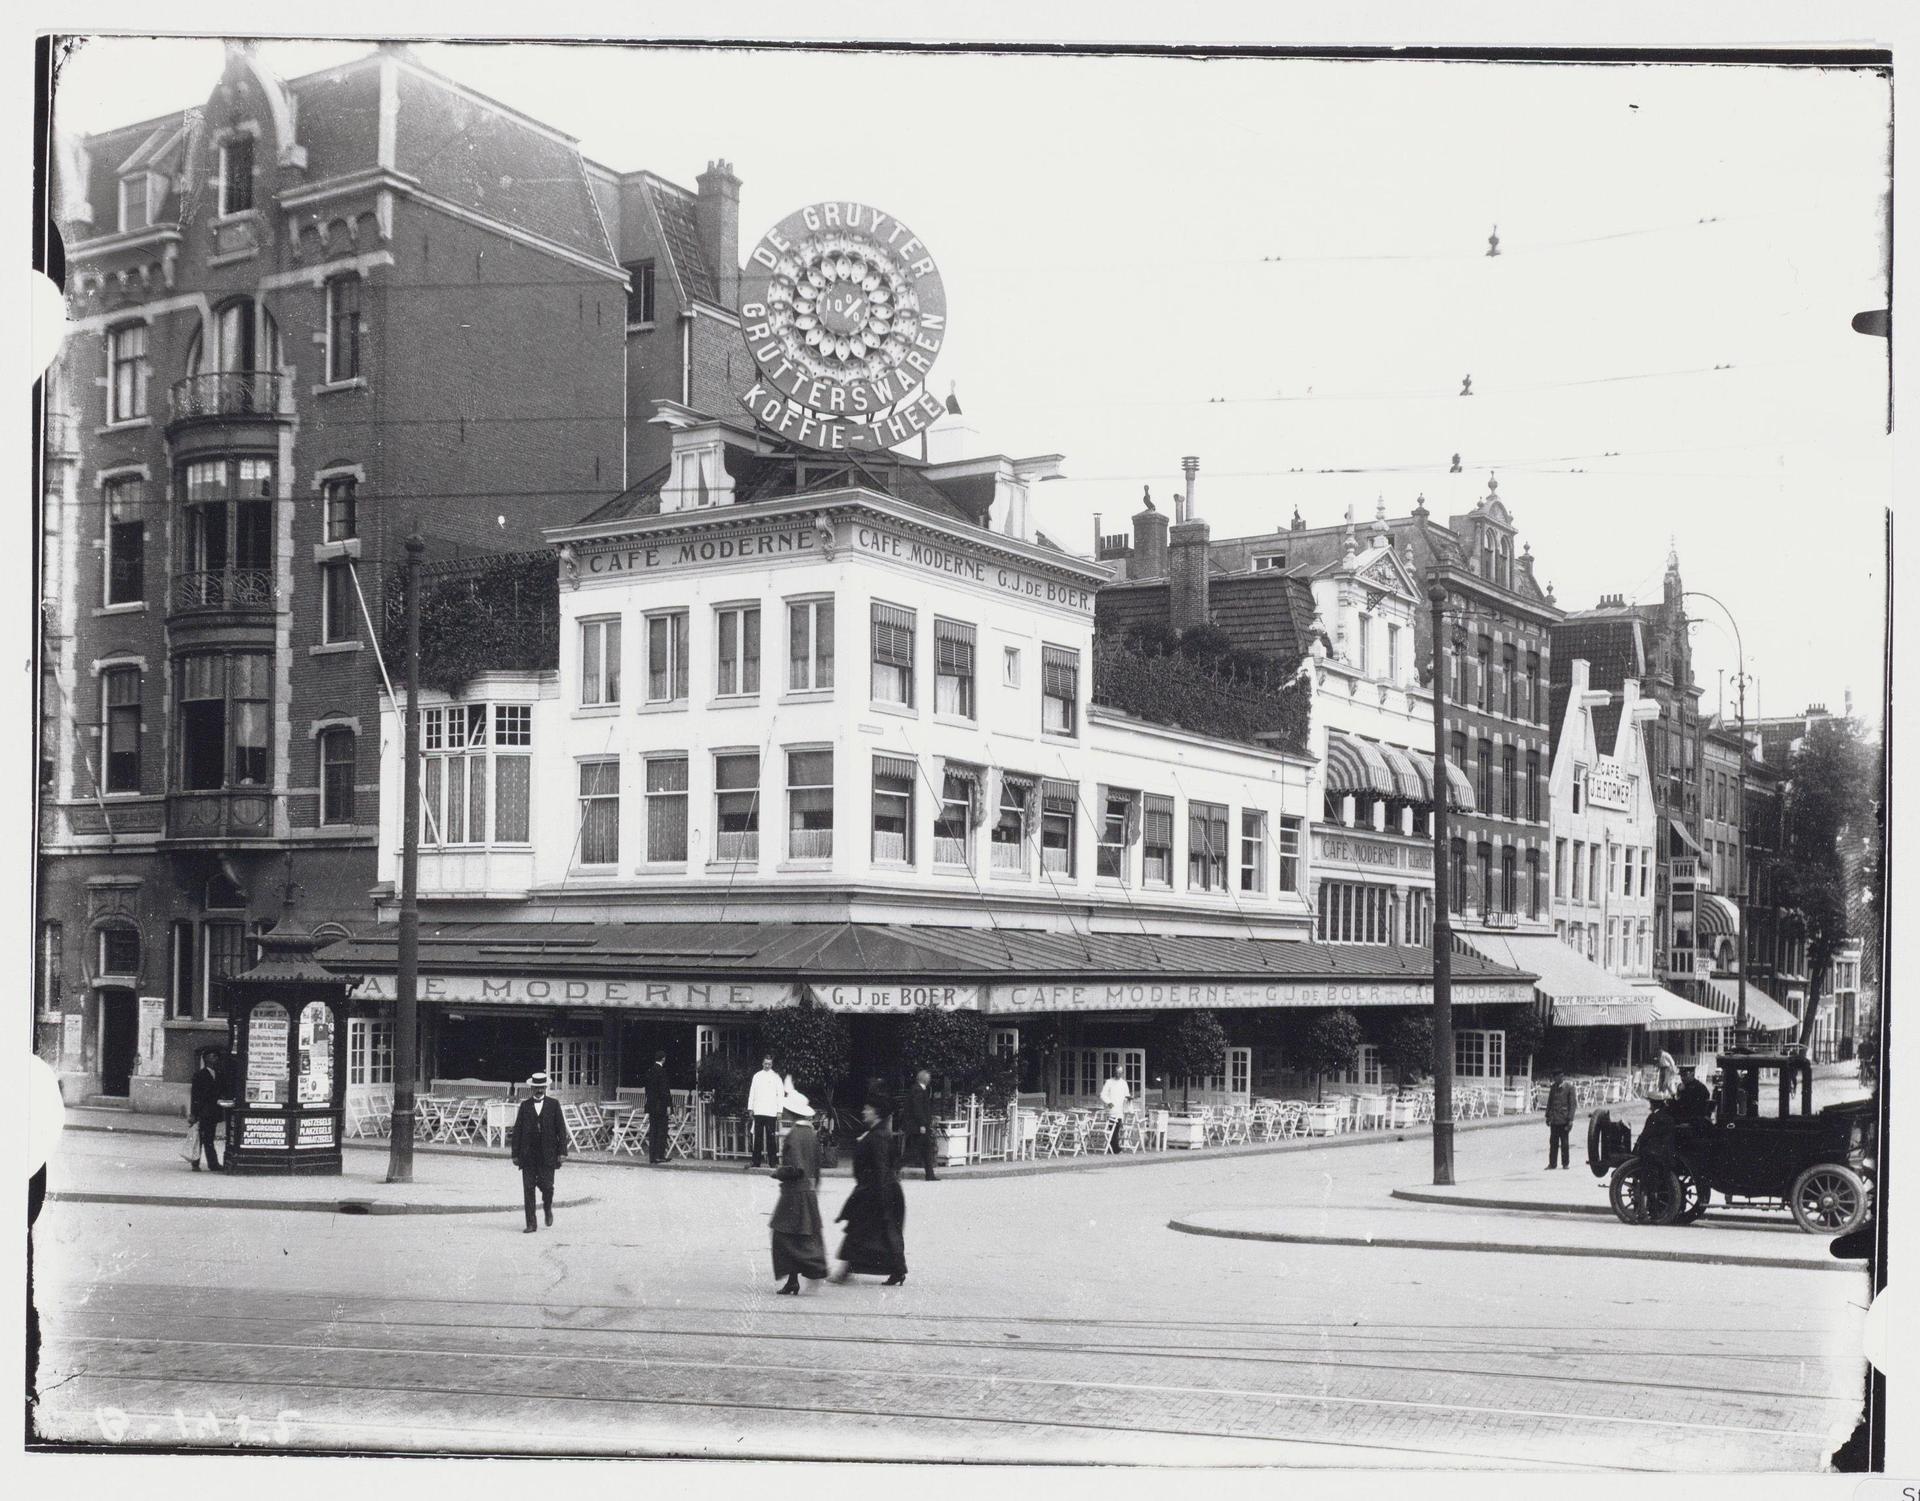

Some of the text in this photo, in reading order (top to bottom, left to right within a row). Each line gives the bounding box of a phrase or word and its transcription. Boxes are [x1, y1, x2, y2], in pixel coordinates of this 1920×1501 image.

[752, 203, 935, 278] DE GRUYTER
[742, 303, 945, 412] GRUTTERSWAREN
[481, 979, 755, 1004] MODERNE
[900, 986, 956, 1007] BOER
[1011, 986, 1085, 1005] CAFE
[1106, 985, 1234, 1003] MODERNE
[1327, 985, 1379, 1001] BOER
[1403, 985, 1433, 1000] CAF
[300, 1117, 332, 1127] POSTZEGELS
